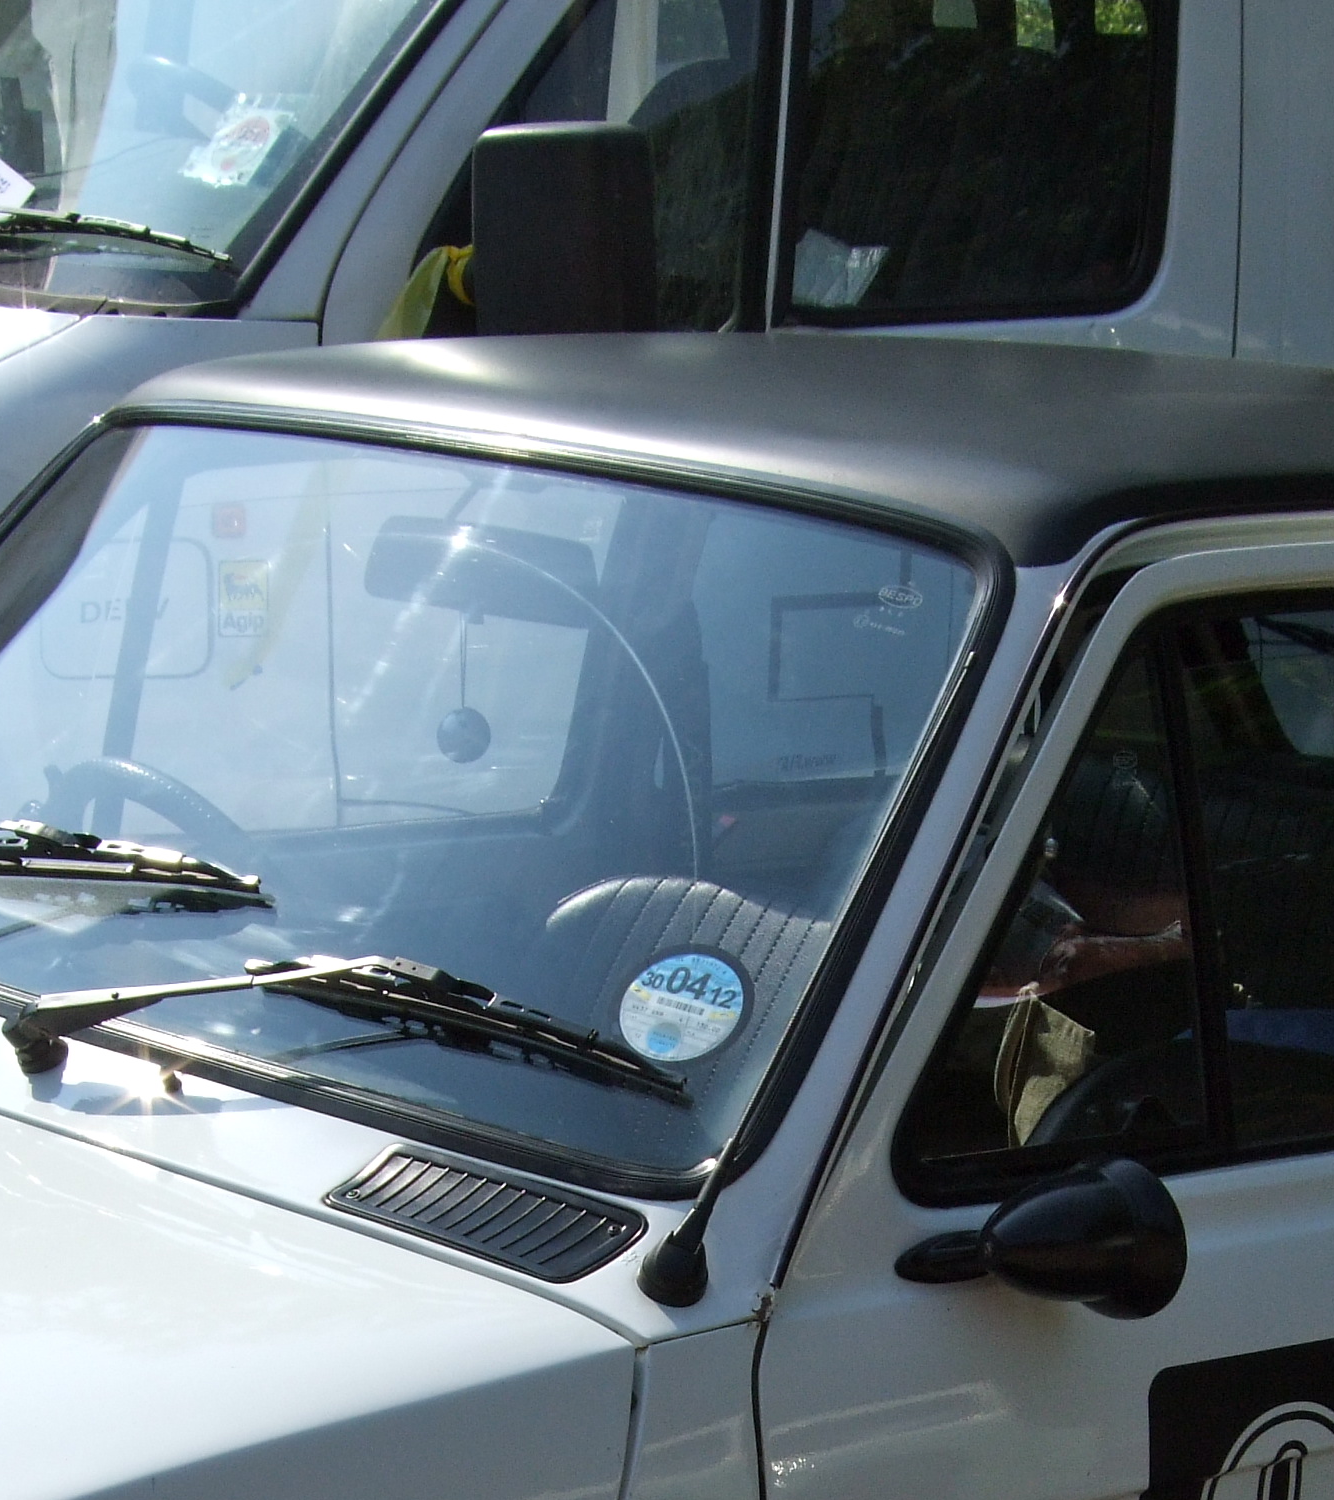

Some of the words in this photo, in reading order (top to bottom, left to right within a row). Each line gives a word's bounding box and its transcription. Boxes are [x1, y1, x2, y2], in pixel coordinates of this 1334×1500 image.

[223, 613, 265, 633] Agip
[641, 971, 665, 989] 30
[666, 966, 712, 1000] 04
[710, 986, 737, 1009] 12
